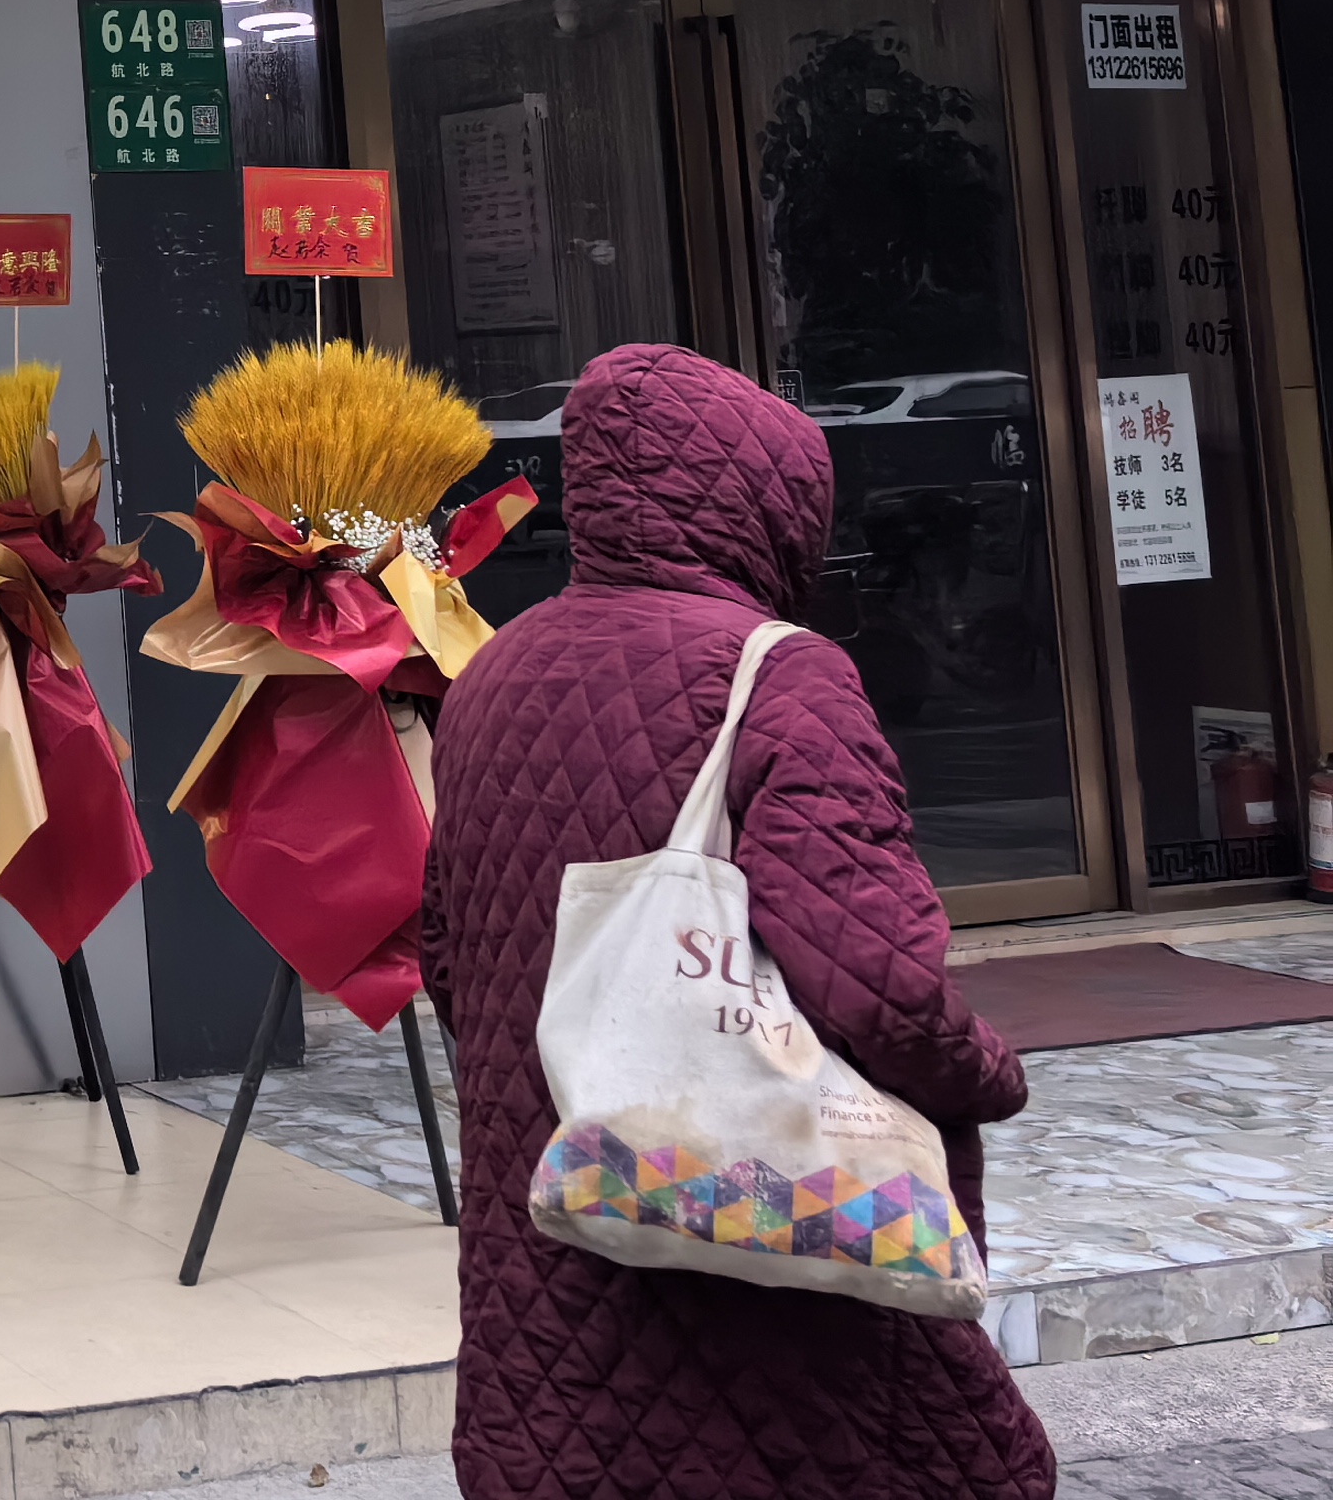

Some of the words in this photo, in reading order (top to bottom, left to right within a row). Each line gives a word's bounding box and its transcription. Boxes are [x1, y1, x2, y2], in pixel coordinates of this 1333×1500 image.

[101, 9, 179, 53] 648
[1088, 14, 1180, 50] 门面出租
[111, 62, 174, 78] 航北路
[1088, 56, 1184, 80] 13122615696
[107, 94, 184, 139] 646
[116, 147, 180, 163] 航北路
[1172, 186, 1225, 222] 40元
[1178, 253, 1234, 290] 40元
[1185, 318, 1237, 357] 40元
[1119, 400, 1175, 447] 招聘
[1114, 454, 1143, 476] 技师
[1161, 452, 1184, 473] 3名
[1116, 490, 1146, 511] 学徒
[1165, 486, 1187, 507] 5名
[820, 1105, 872, 1123] Finance
